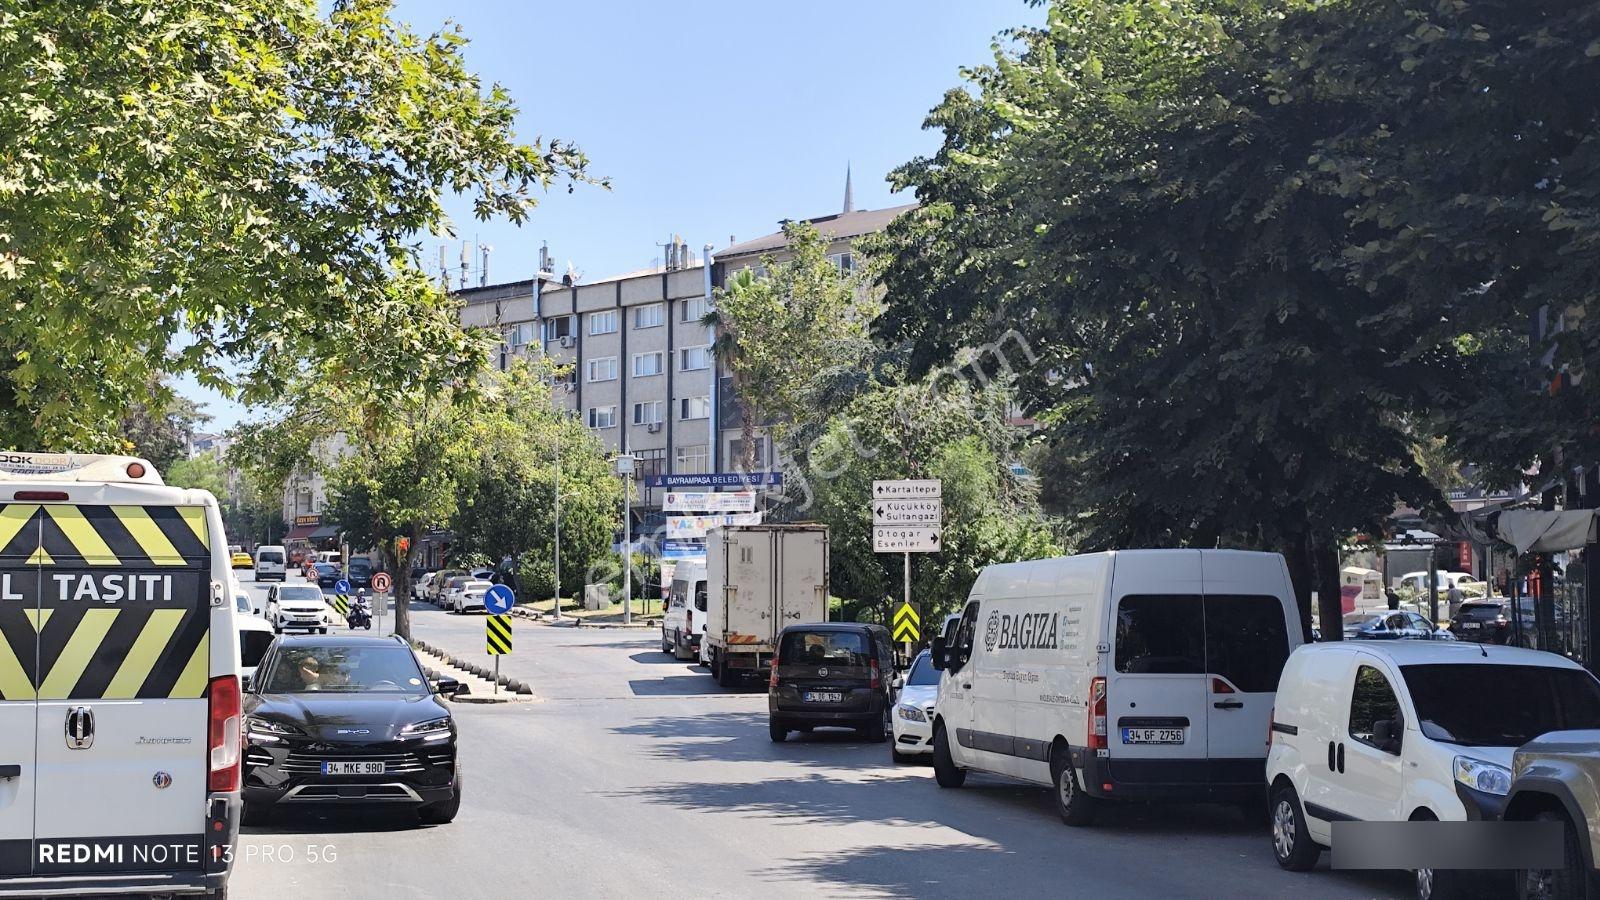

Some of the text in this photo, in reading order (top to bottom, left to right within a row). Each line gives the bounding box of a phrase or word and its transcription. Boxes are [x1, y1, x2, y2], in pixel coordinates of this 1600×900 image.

[667, 475, 760, 485] BAYRAMPAŞA BELEDİYESİ
[885, 485, 937, 495] Kartaltepe
[887, 502, 938, 512] Küçükköy
[886, 513, 938, 521] Sultangazi
[877, 530, 921, 539] Otogar
[2, 574, 172, 603] L TAŞITI
[998, 612, 1058, 650] BAGIZA
[1130, 730, 1182, 740] 34 GF 2756
[328, 763, 382, 773] 34 MKE 980
